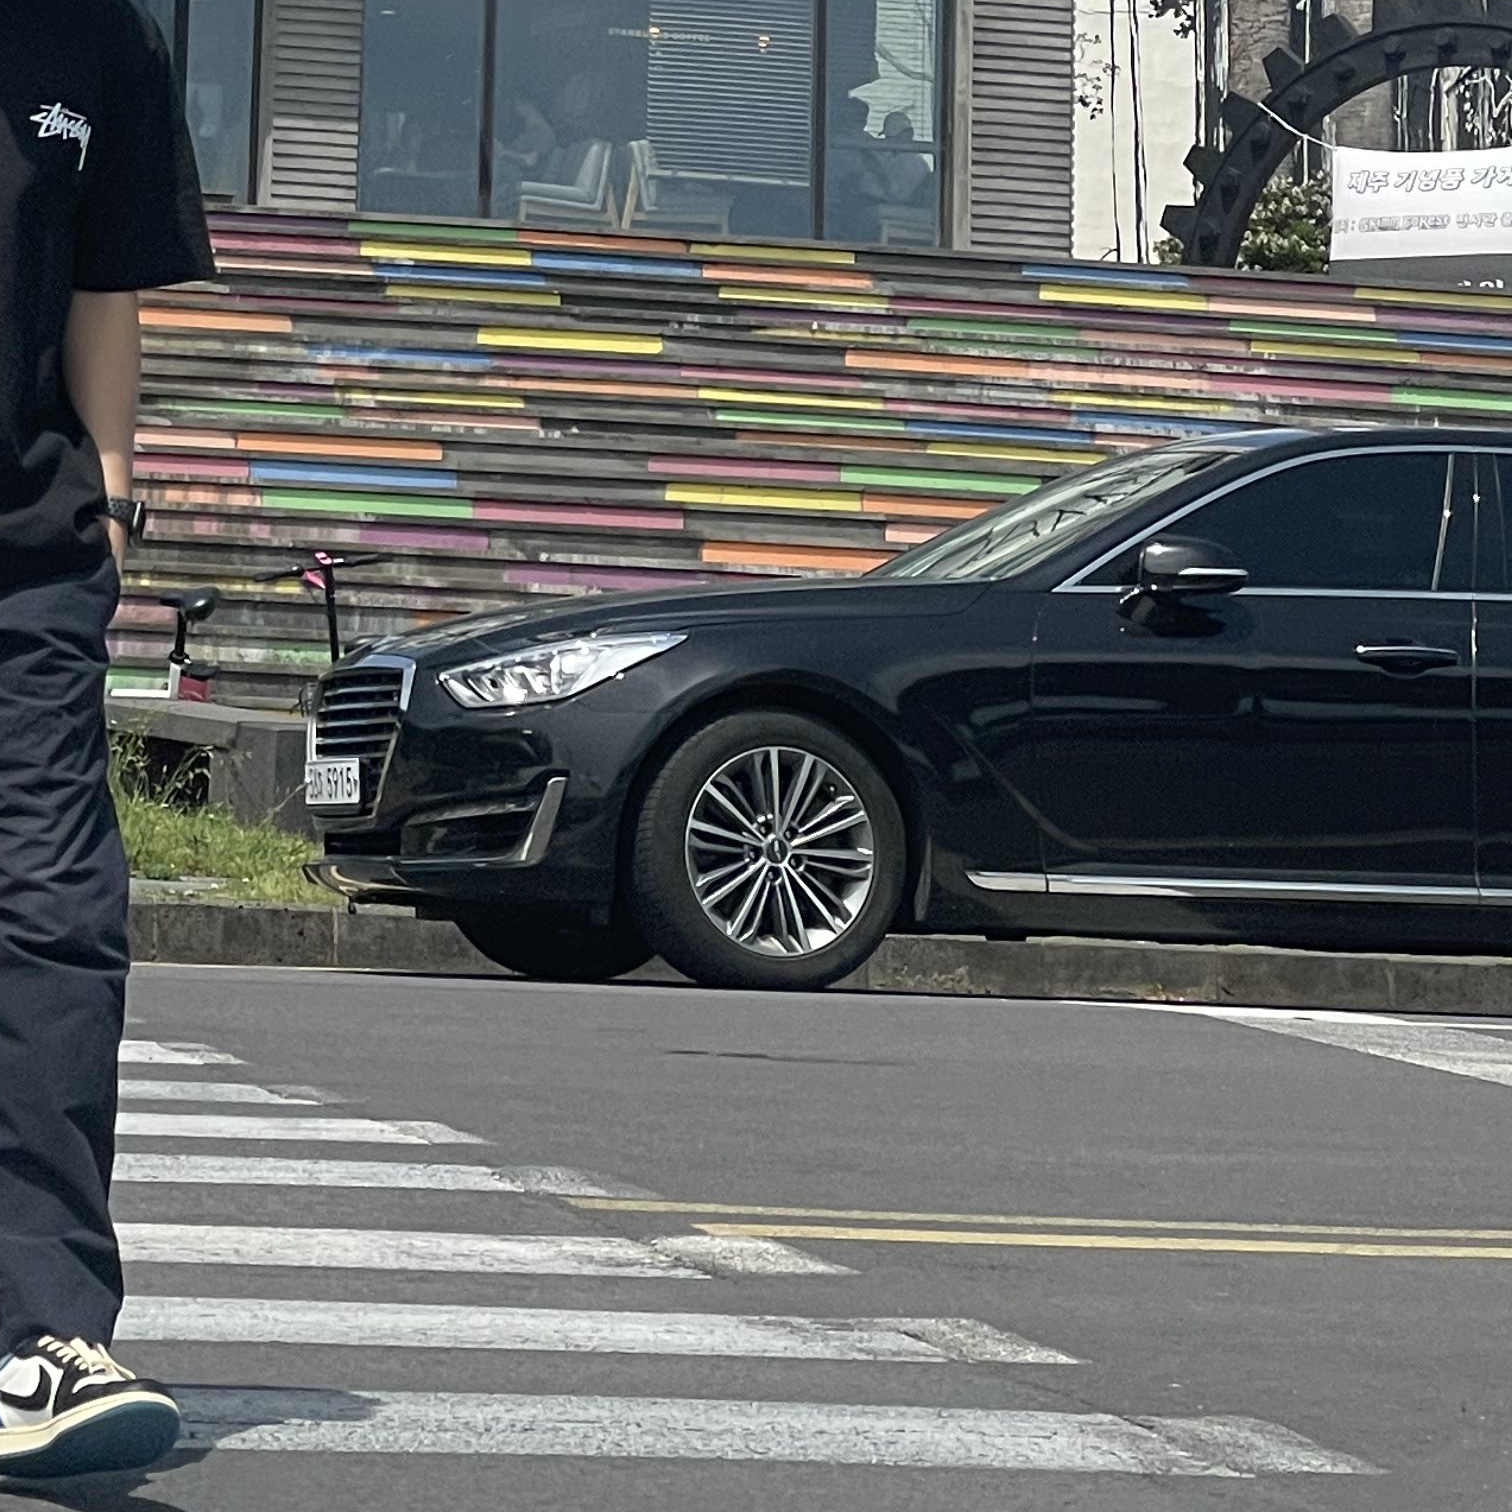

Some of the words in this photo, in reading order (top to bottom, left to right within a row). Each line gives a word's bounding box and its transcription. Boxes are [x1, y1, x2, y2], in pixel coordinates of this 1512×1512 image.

[1348, 170, 1390, 194] 제주
[1394, 168, 1465, 193] 기념품
[326, 766, 353, 799] 5915
